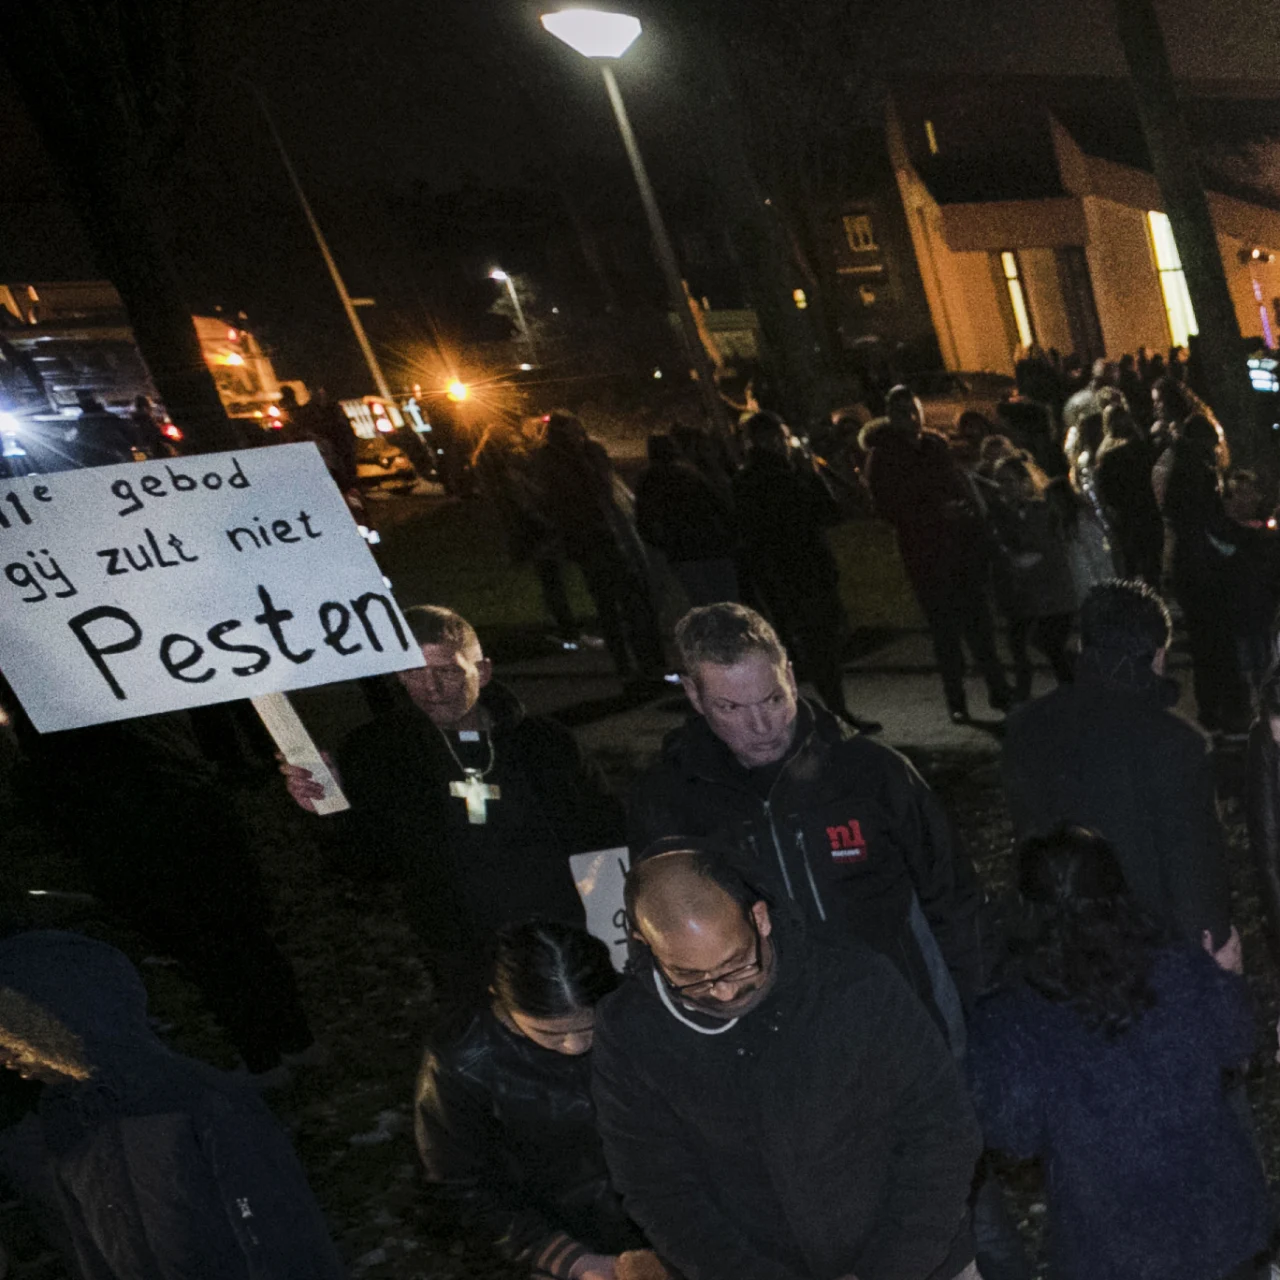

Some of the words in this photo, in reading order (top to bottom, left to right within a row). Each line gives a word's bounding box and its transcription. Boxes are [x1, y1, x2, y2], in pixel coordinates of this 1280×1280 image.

[111, 458, 251, 516] gebod
[225, 511, 322, 553] niet
[67, 584, 410, 701] Pesten
